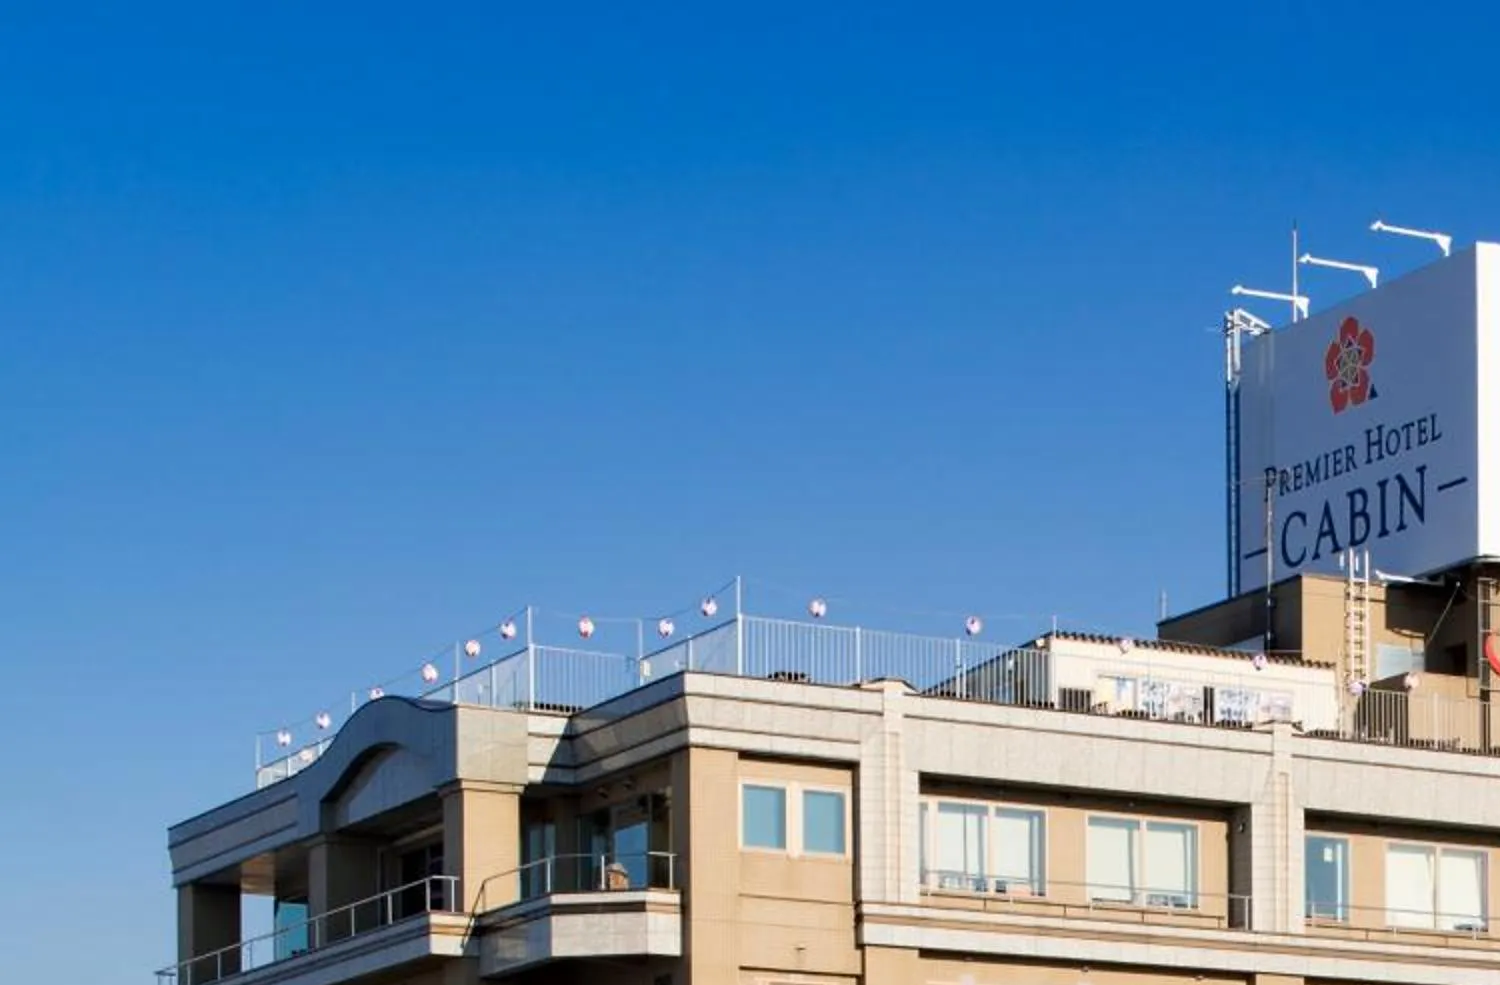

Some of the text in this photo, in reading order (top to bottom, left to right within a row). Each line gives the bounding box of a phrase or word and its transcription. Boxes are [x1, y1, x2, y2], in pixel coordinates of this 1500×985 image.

[1263, 412, 1443, 503] PREMIER HOTEL
[1280, 463, 1428, 569] CABIN
